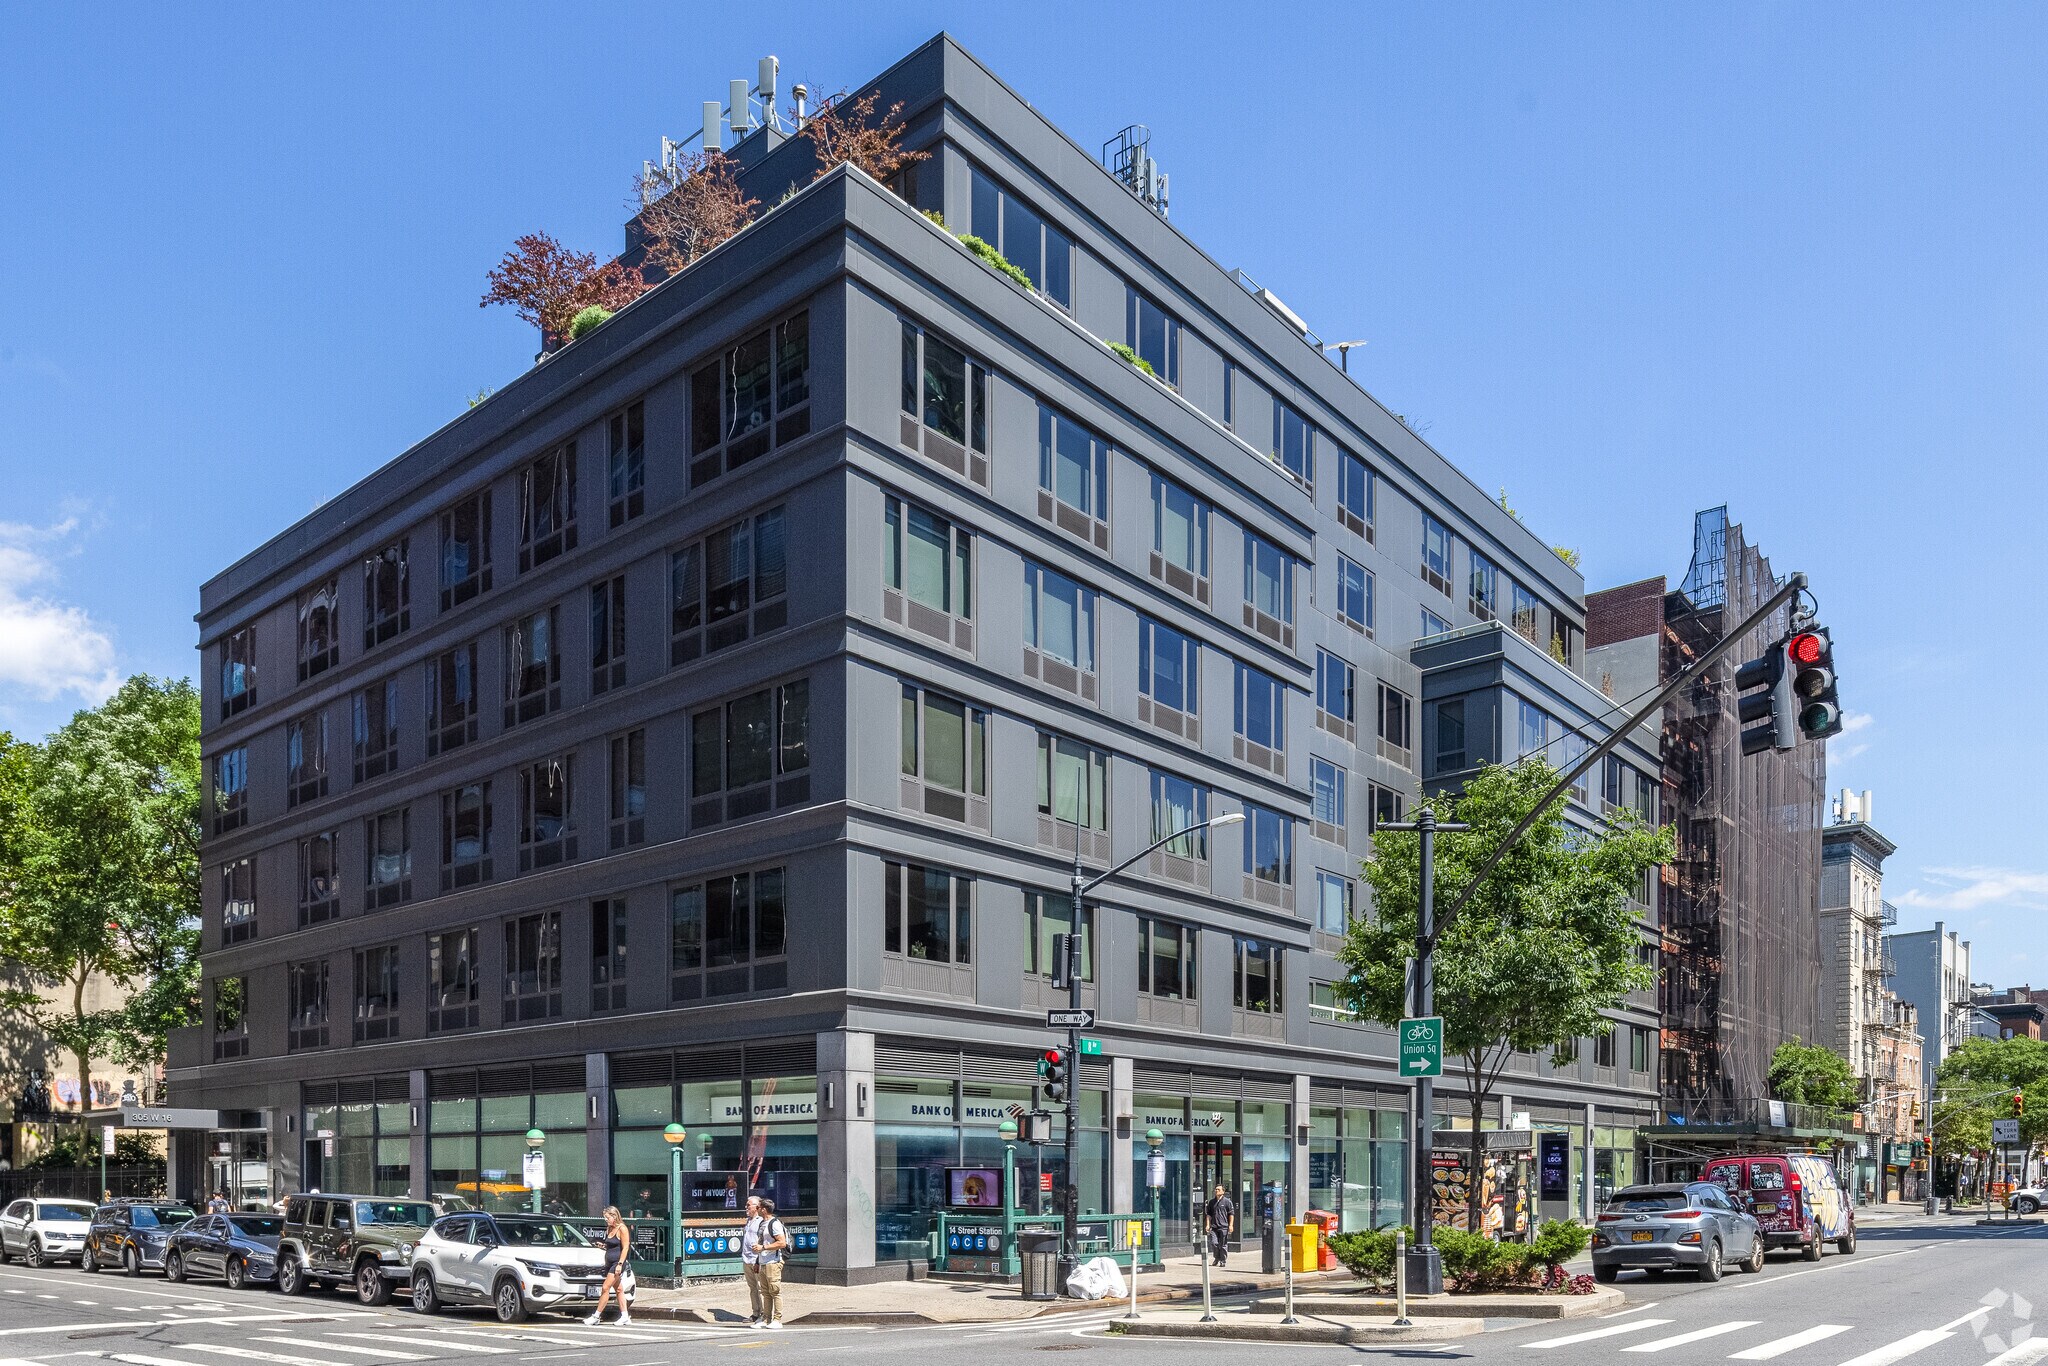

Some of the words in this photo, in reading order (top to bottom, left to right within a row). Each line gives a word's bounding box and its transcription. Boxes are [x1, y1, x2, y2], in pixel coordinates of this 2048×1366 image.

[1087, 1041, 1092, 1052] 8
[1403, 1044, 1425, 1055] Union
[1427, 1043, 1437, 1055] Sq
[1039, 1062, 1046, 1074] W
[726, 1106, 743, 1116] BAN
[753, 1105, 766, 1115] OF
[767, 1103, 813, 1115] AMERICA
[911, 1105, 941, 1116] BANK
[943, 1106, 954, 1116] O
[966, 1107, 1004, 1118] MERICA
[132, 1113, 149, 1122] 305
[150, 1113, 159, 1122] W
[162, 1114, 172, 1123] 16
[1145, 1116, 1166, 1125] BANK
[1167, 1117, 1177, 1125] OF
[1178, 1117, 1210, 1127] ARICA
[1212, 1112, 1221, 1120] 127
[728, 1189, 734, 1197] G
[582, 1227, 607, 1240] Subway
[685, 1228, 693, 1239] 14
[695, 1229, 717, 1238] Street
[718, 1229, 744, 1237] Station
[949, 1226, 956, 1234] 14
[957, 1226, 978, 1235] Street
[978, 1227, 1003, 1236] Station
[1076, 1226, 1091, 1236] way
[687, 1241, 696, 1251] A
[702, 1240, 710, 1250] C
[717, 1240, 724, 1250] E
[731, 1240, 738, 1249] L
[951, 1237, 958, 1247] A
[964, 1237, 971, 1247] C
[977, 1238, 984, 1248] E
[990, 1238, 997, 1248] L
